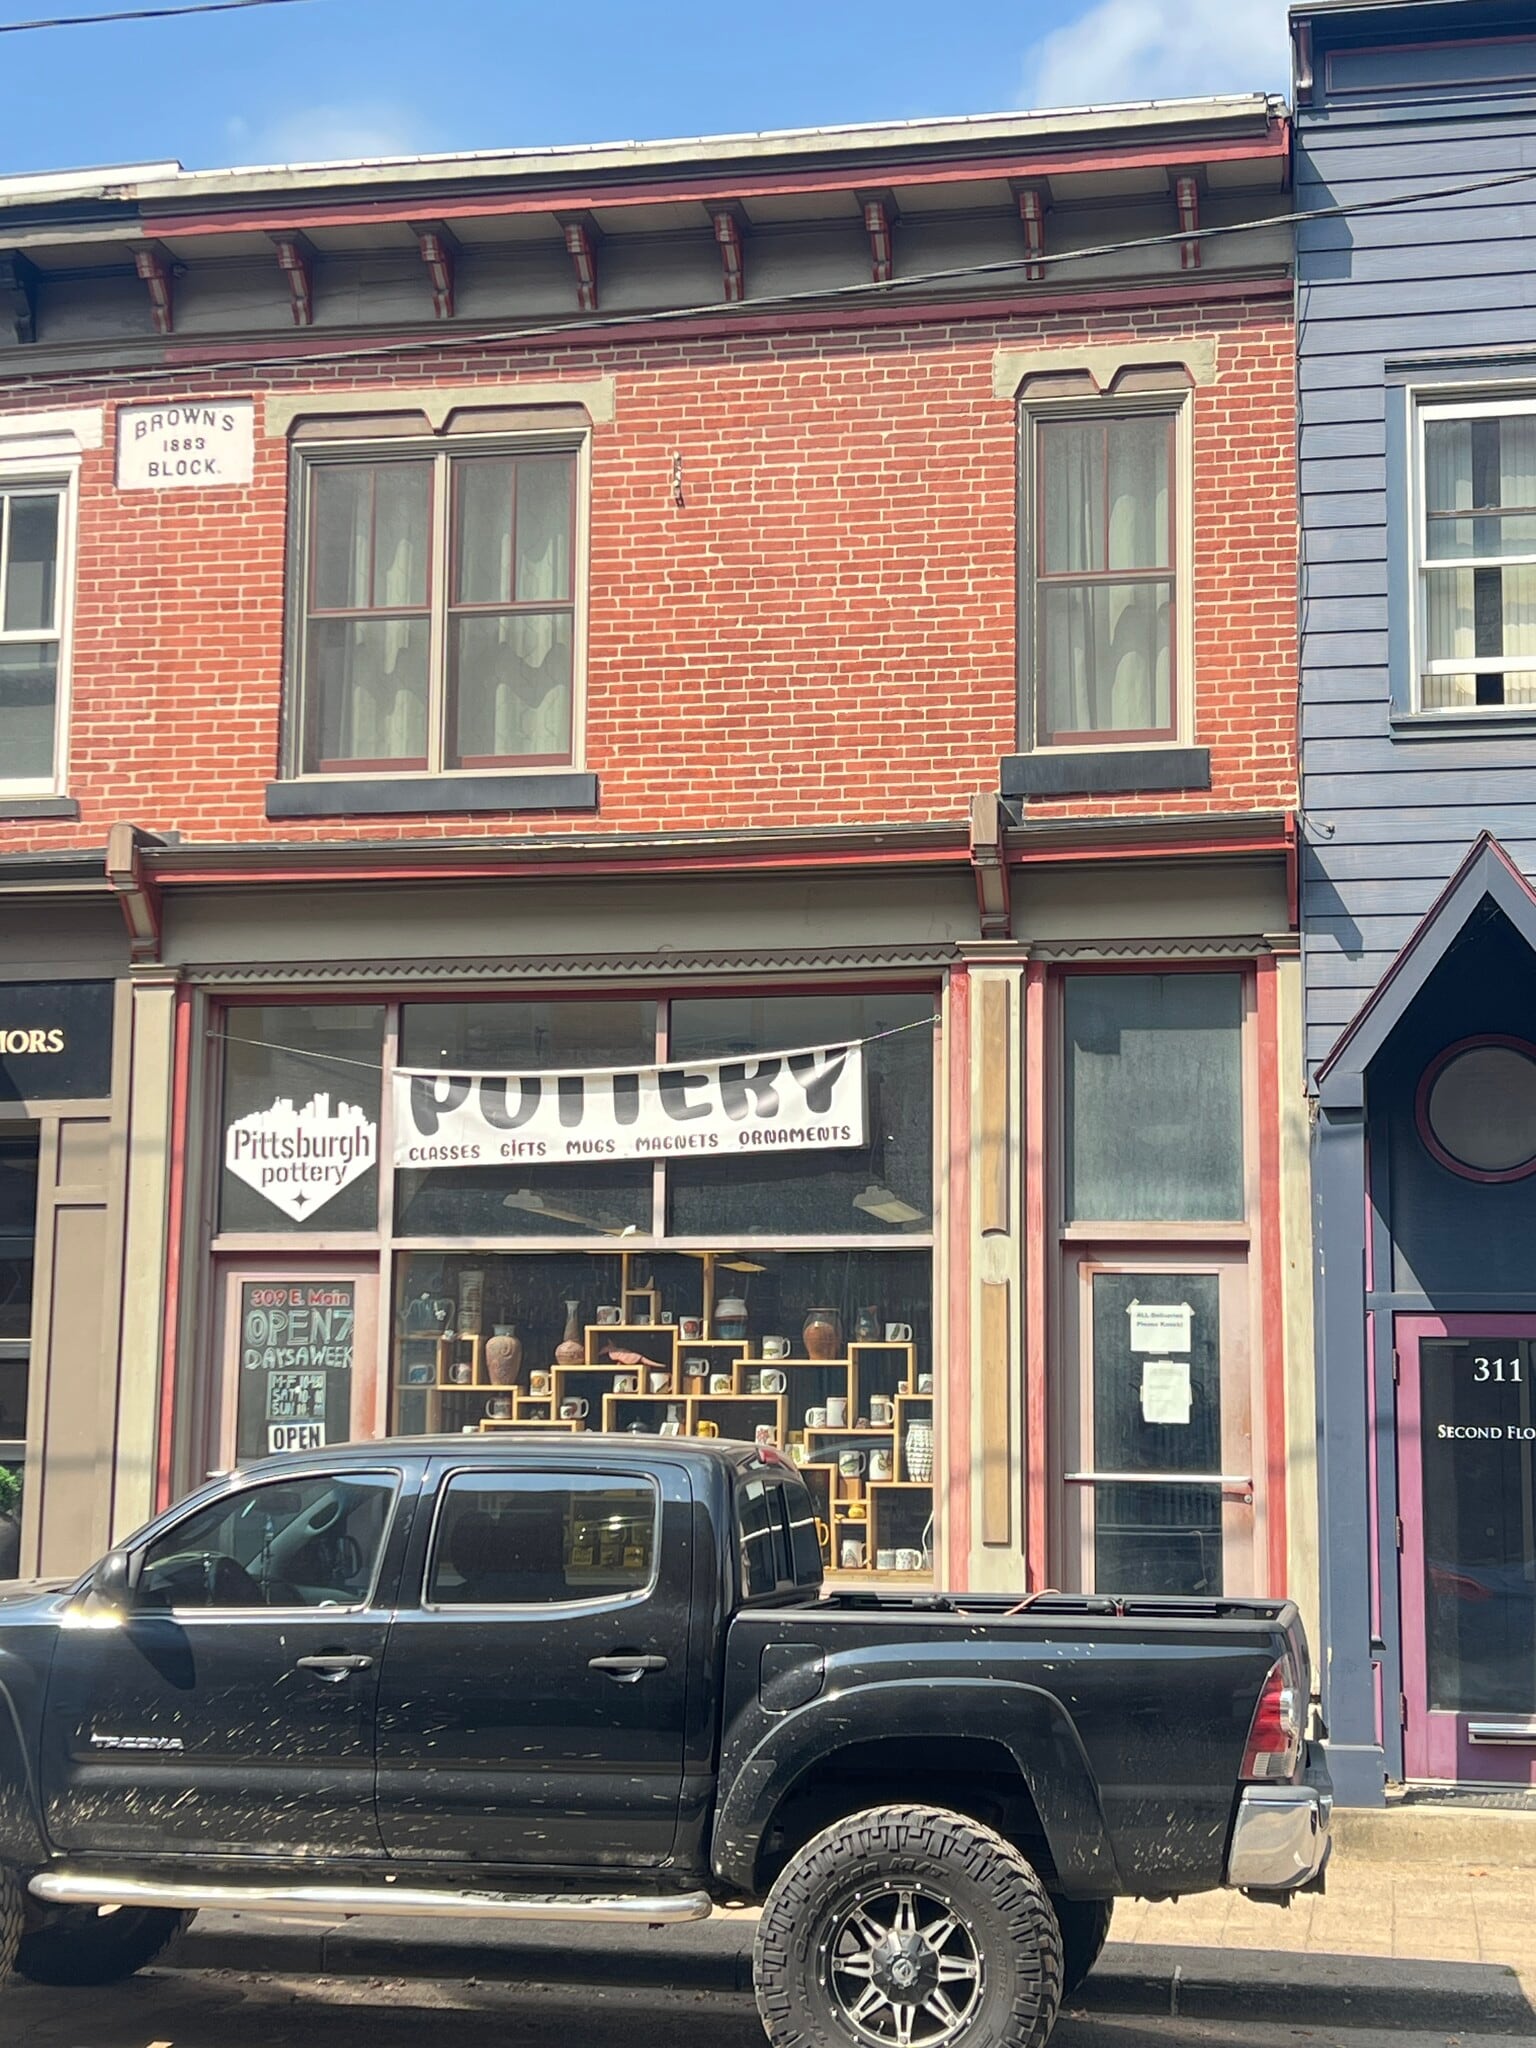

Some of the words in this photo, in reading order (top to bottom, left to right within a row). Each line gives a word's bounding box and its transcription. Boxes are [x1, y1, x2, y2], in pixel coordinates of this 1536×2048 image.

[134, 407, 236, 442] BROWNS
[162, 437, 206, 453] 1883
[234, 1126, 370, 1164] Pittsburgh
[409, 1144, 481, 1162] CLASSES
[566, 1138, 616, 1156] MUGS
[635, 1132, 719, 1152] MAGNETS
[738, 1125, 852, 1146] ORNAMENTS
[261, 1161, 348, 1188] pottery
[251, 1289, 287, 1307] 309
[307, 1288, 350, 1306] Main
[246, 1308, 332, 1347] OPEN
[244, 1347, 295, 1370] DAYS
[296, 1346, 309, 1366] A
[309, 1345, 354, 1369] WEEK
[1473, 1357, 1523, 1383] 311
[273, 1425, 321, 1451] OPEN
[1437, 1424, 1503, 1440] SECOND
